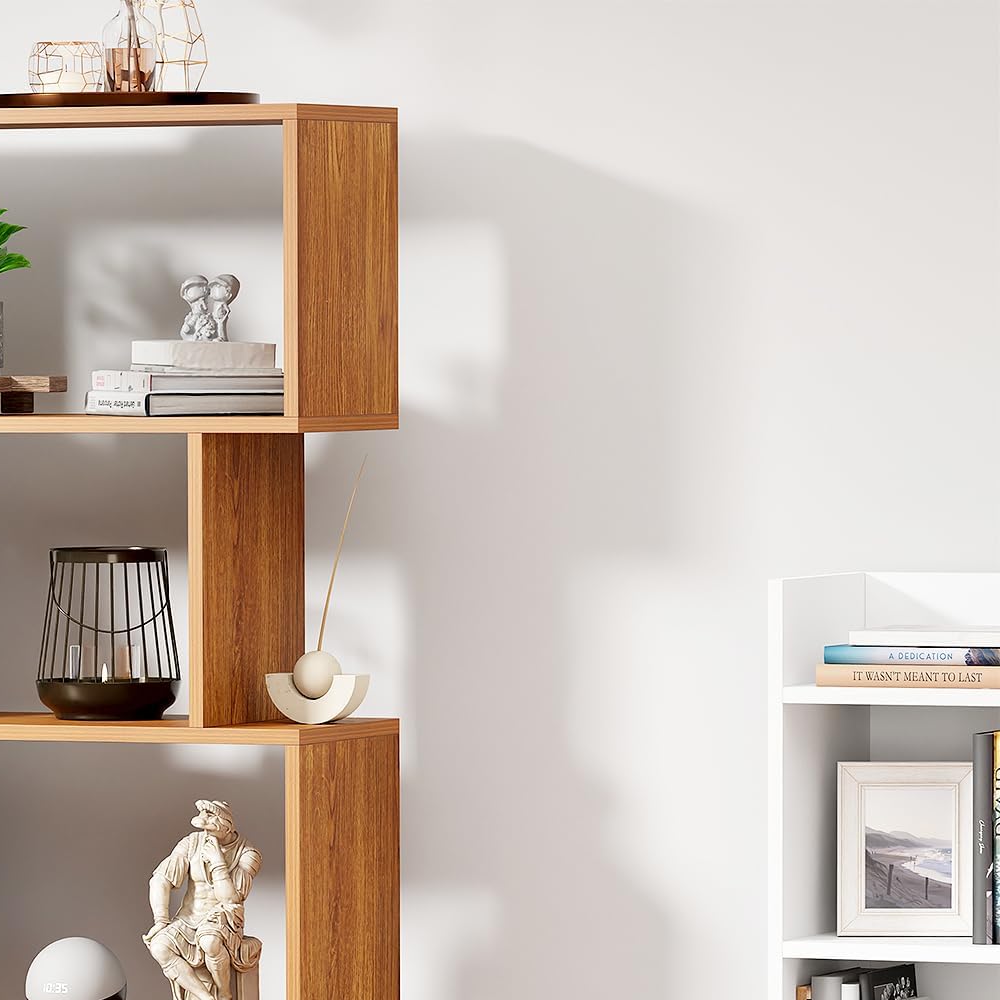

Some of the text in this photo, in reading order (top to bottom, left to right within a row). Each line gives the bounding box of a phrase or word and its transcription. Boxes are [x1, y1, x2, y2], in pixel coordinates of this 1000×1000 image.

[888, 652, 953, 661] A DEDICATION
[852, 671, 983, 683] IT WASN'T MEANT TO LAST
